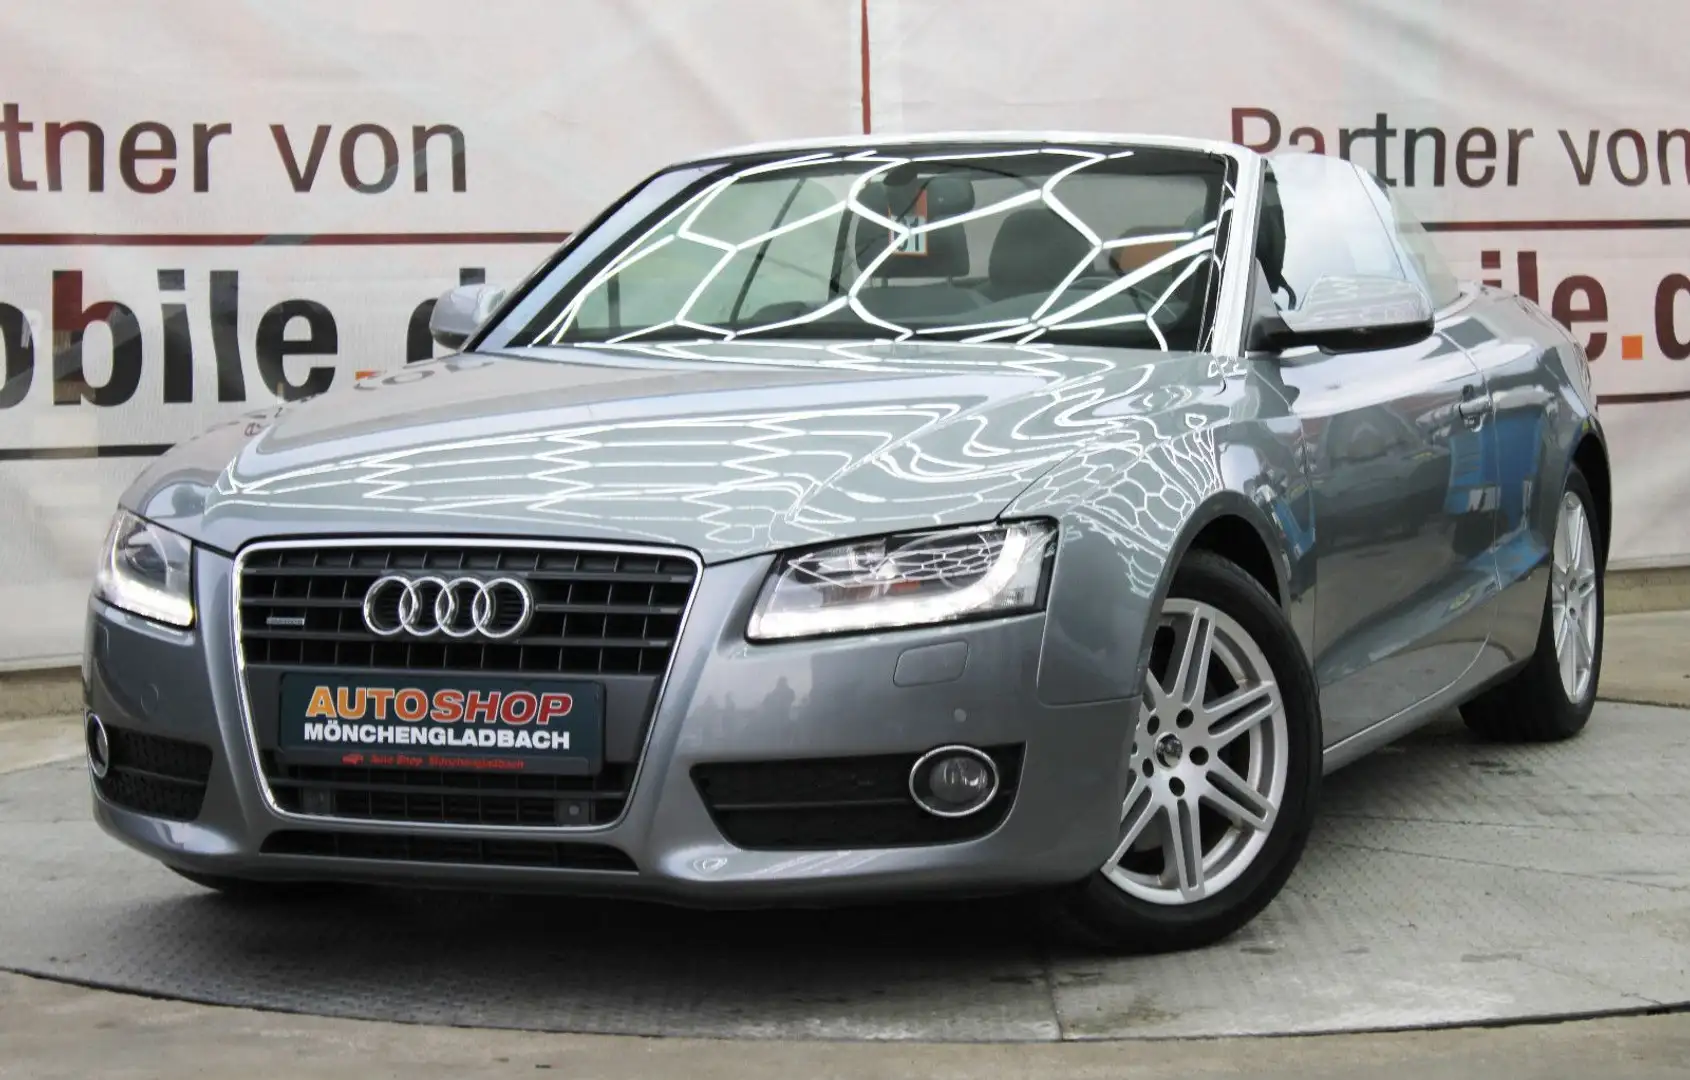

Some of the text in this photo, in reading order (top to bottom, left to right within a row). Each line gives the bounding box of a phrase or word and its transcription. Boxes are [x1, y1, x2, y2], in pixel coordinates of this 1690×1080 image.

[0, 103, 467, 194] tner von
[1557, 127, 1690, 188] von
[304, 685, 574, 725] AUTOSHOP
[303, 720, 571, 751] MÖNCHENGLADBACH
